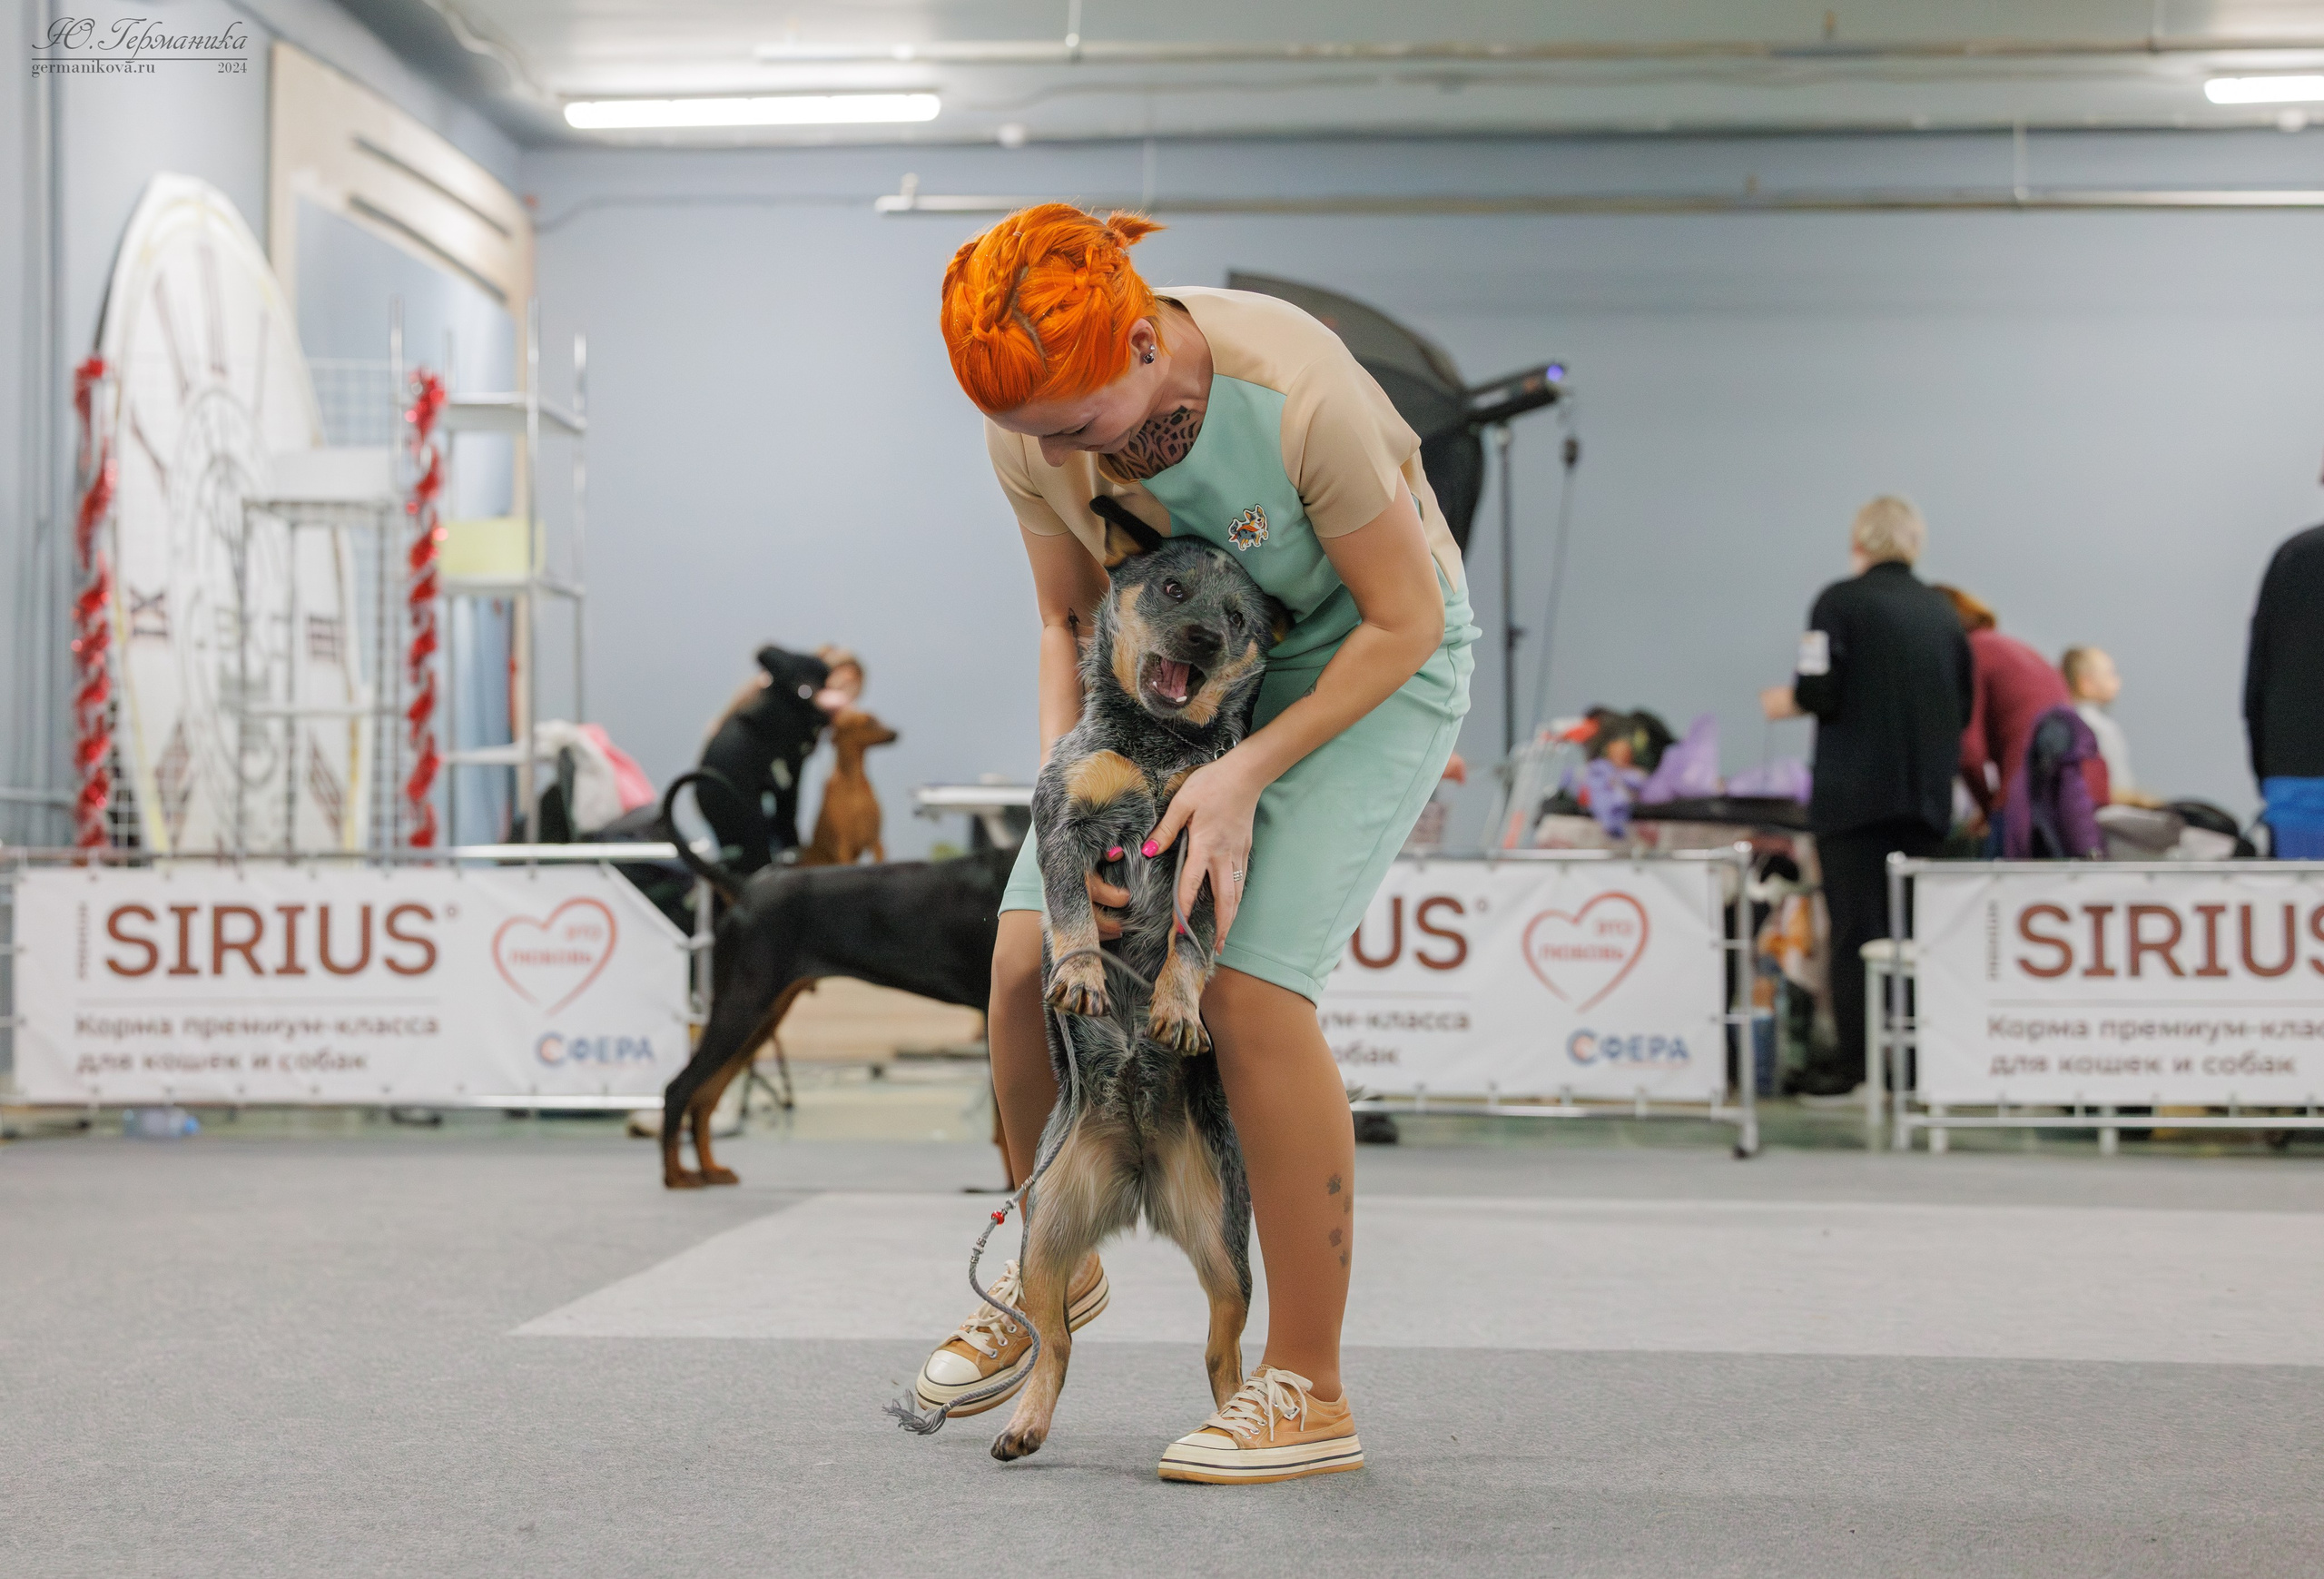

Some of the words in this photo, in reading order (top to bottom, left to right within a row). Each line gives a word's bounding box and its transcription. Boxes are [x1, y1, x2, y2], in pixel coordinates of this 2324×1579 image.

[106, 903, 438, 977] SIRIUS
[2016, 903, 2324, 978] SIRIU
[75, 1014, 173, 1041] Корма
[183, 1016, 439, 1042] премиум-класса
[1988, 1015, 2089, 1042] Корма
[78, 1053, 133, 1075] для
[143, 1053, 239, 1073] кошек
[252, 1054, 270, 1072] и
[279, 1047, 368, 1072] собак
[536, 1031, 655, 1068] СФЕРА
[1566, 1028, 1689, 1068] СФЕРА
[1990, 1055, 2048, 1075] для
[2058, 1055, 2160, 1075] кошек
[2173, 1057, 2193, 1073] и
[2203, 1049, 2296, 1075] собак
